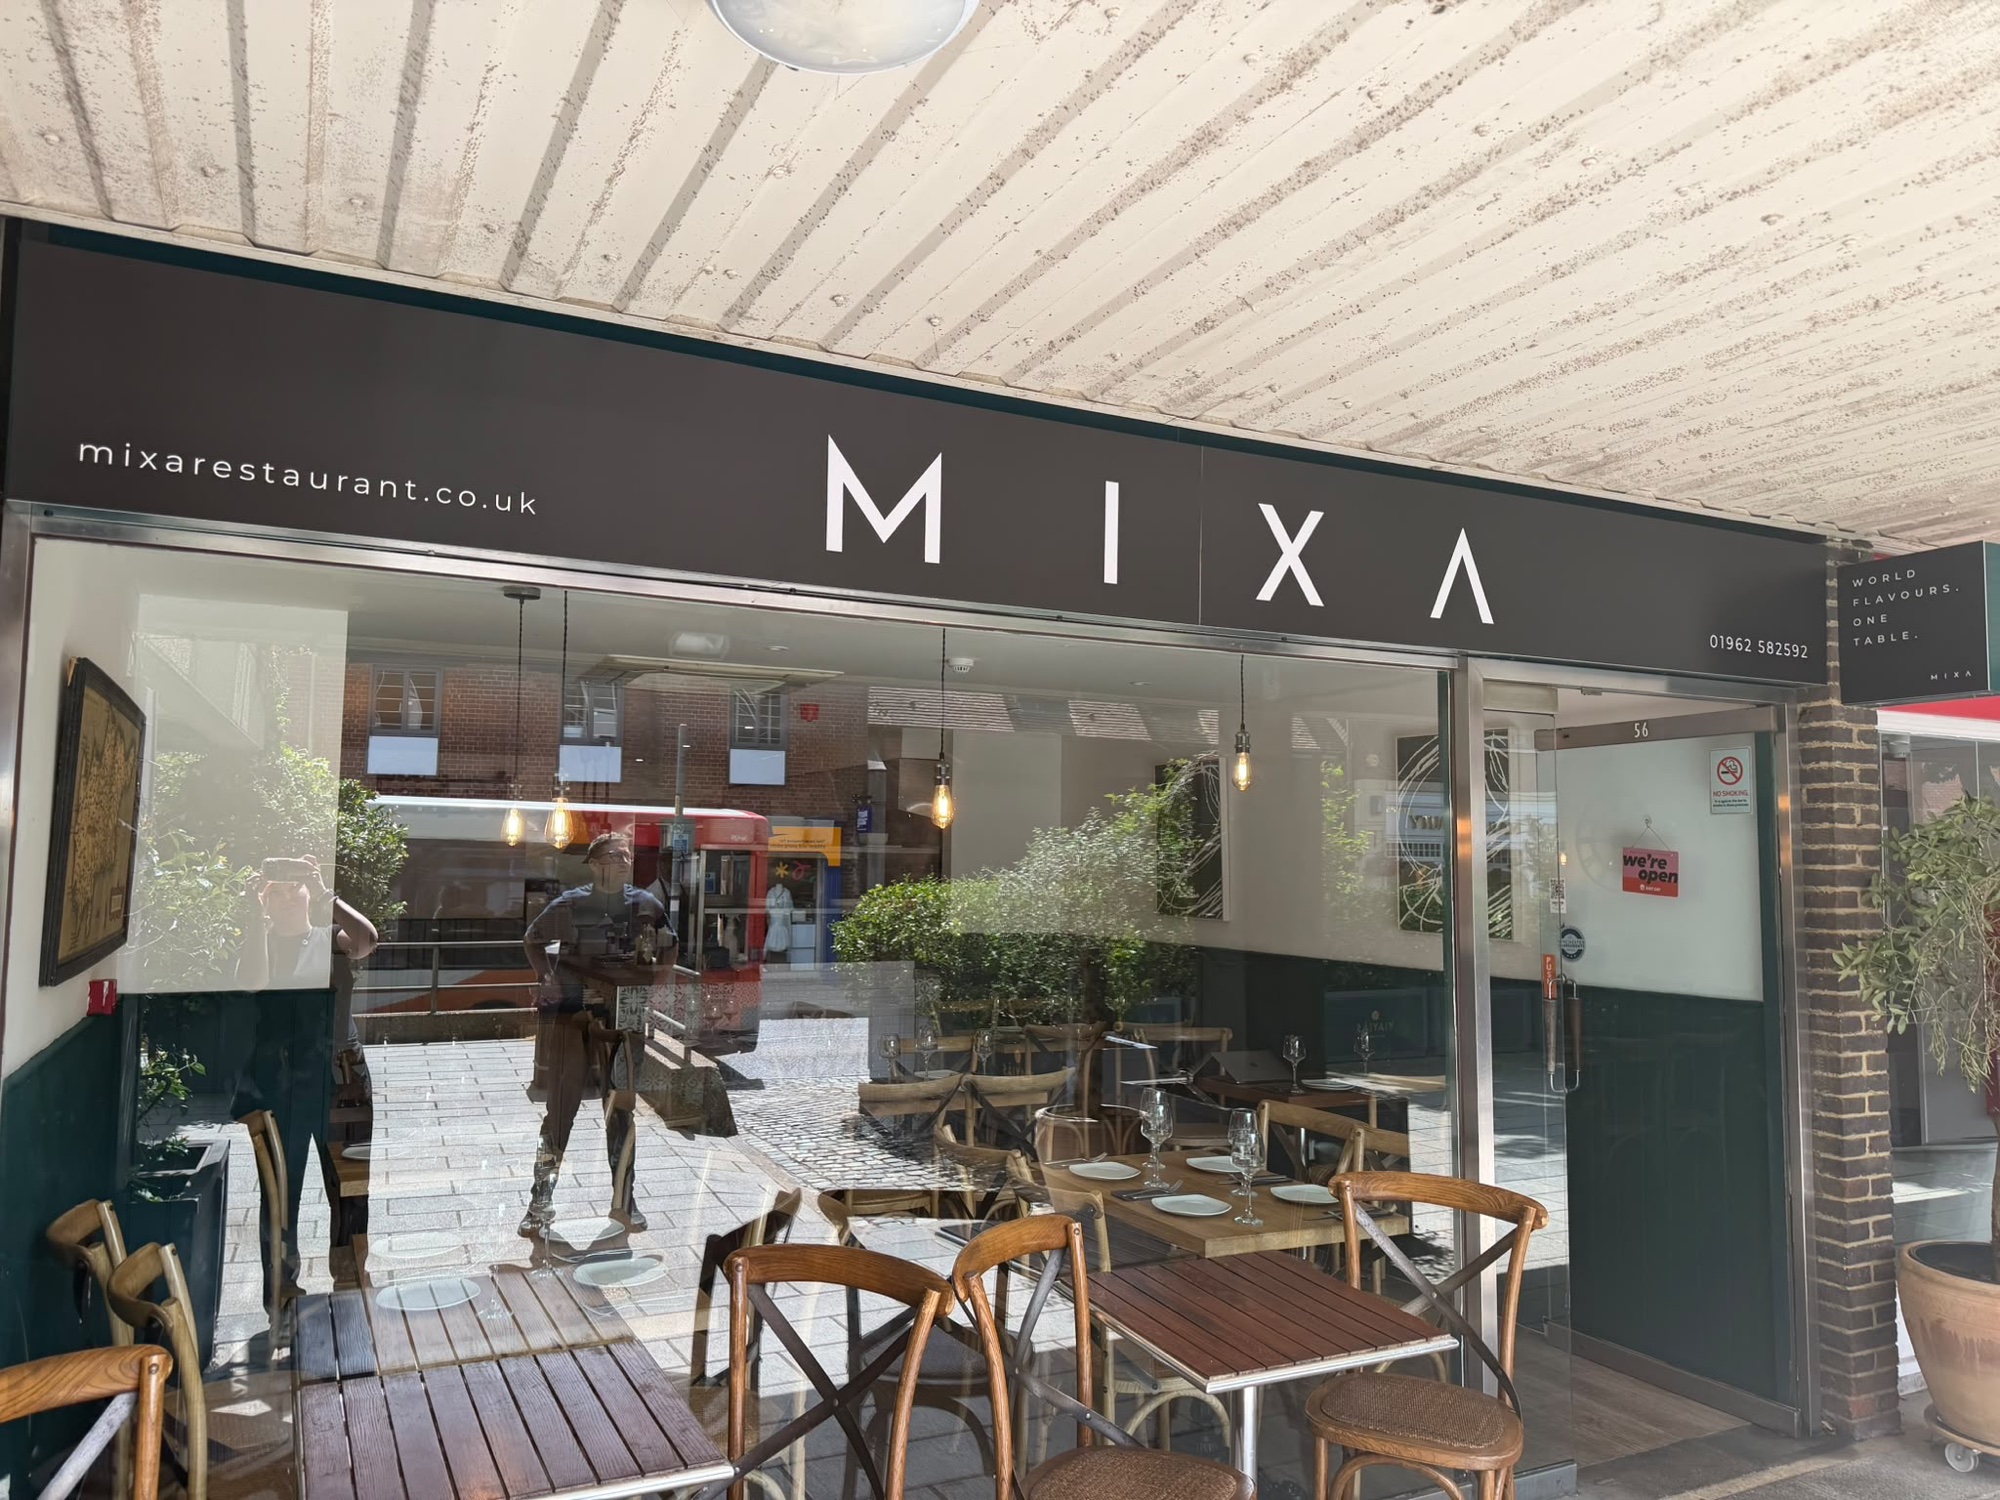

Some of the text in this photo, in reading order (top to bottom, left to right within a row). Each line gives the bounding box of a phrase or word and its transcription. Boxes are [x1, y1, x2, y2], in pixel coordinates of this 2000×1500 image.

[78, 442, 537, 516] mixarestaurant.co.uk
[1852, 569, 1916, 588] WORLD
[1853, 583, 1960, 607] FLAVOURS.
[1853, 613, 1888, 627] ONE
[1709, 634, 1808, 659] 01962 582592
[1853, 630, 1919, 647] TABLE.
[1634, 722, 1649, 738] 56
[1623, 853, 1667, 869] we're
[1638, 869, 1678, 884] open
